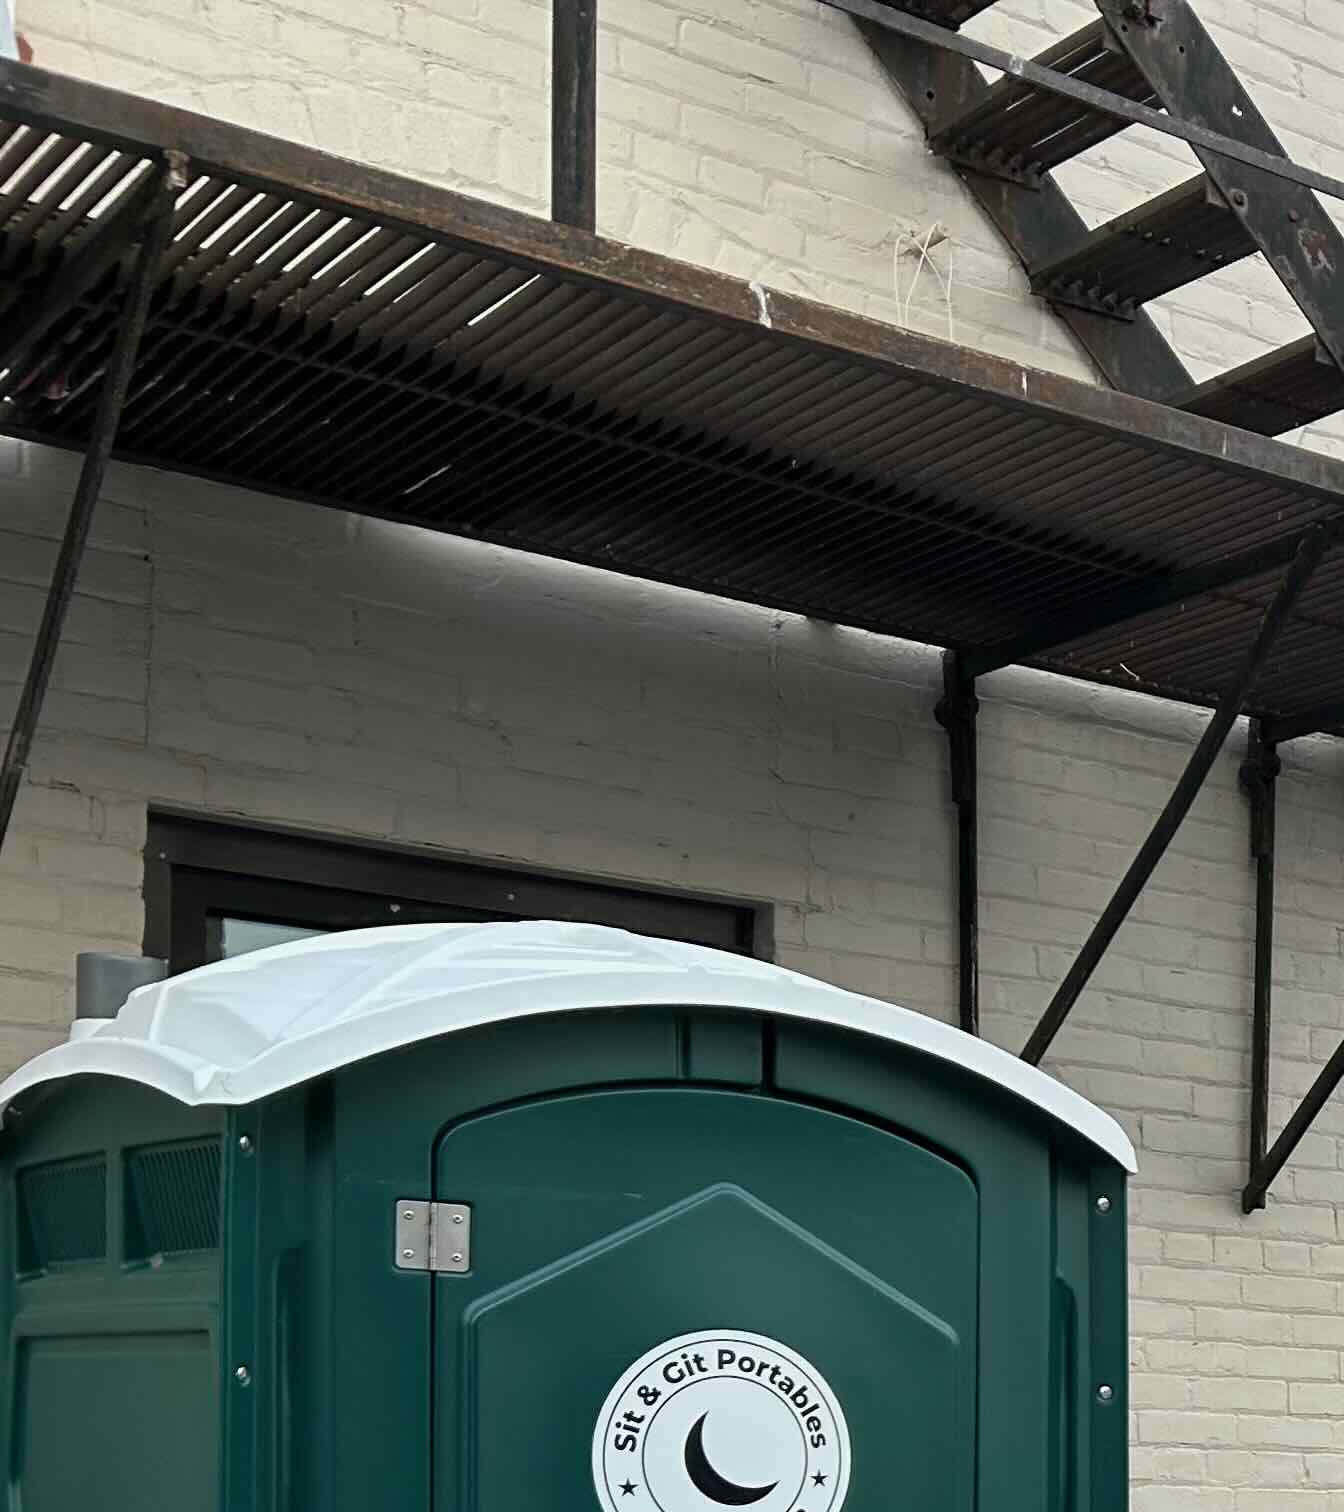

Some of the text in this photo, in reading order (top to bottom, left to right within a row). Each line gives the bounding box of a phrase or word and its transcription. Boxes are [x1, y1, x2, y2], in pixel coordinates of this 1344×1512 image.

[614, 1348, 827, 1453] Sit & Git Portables
